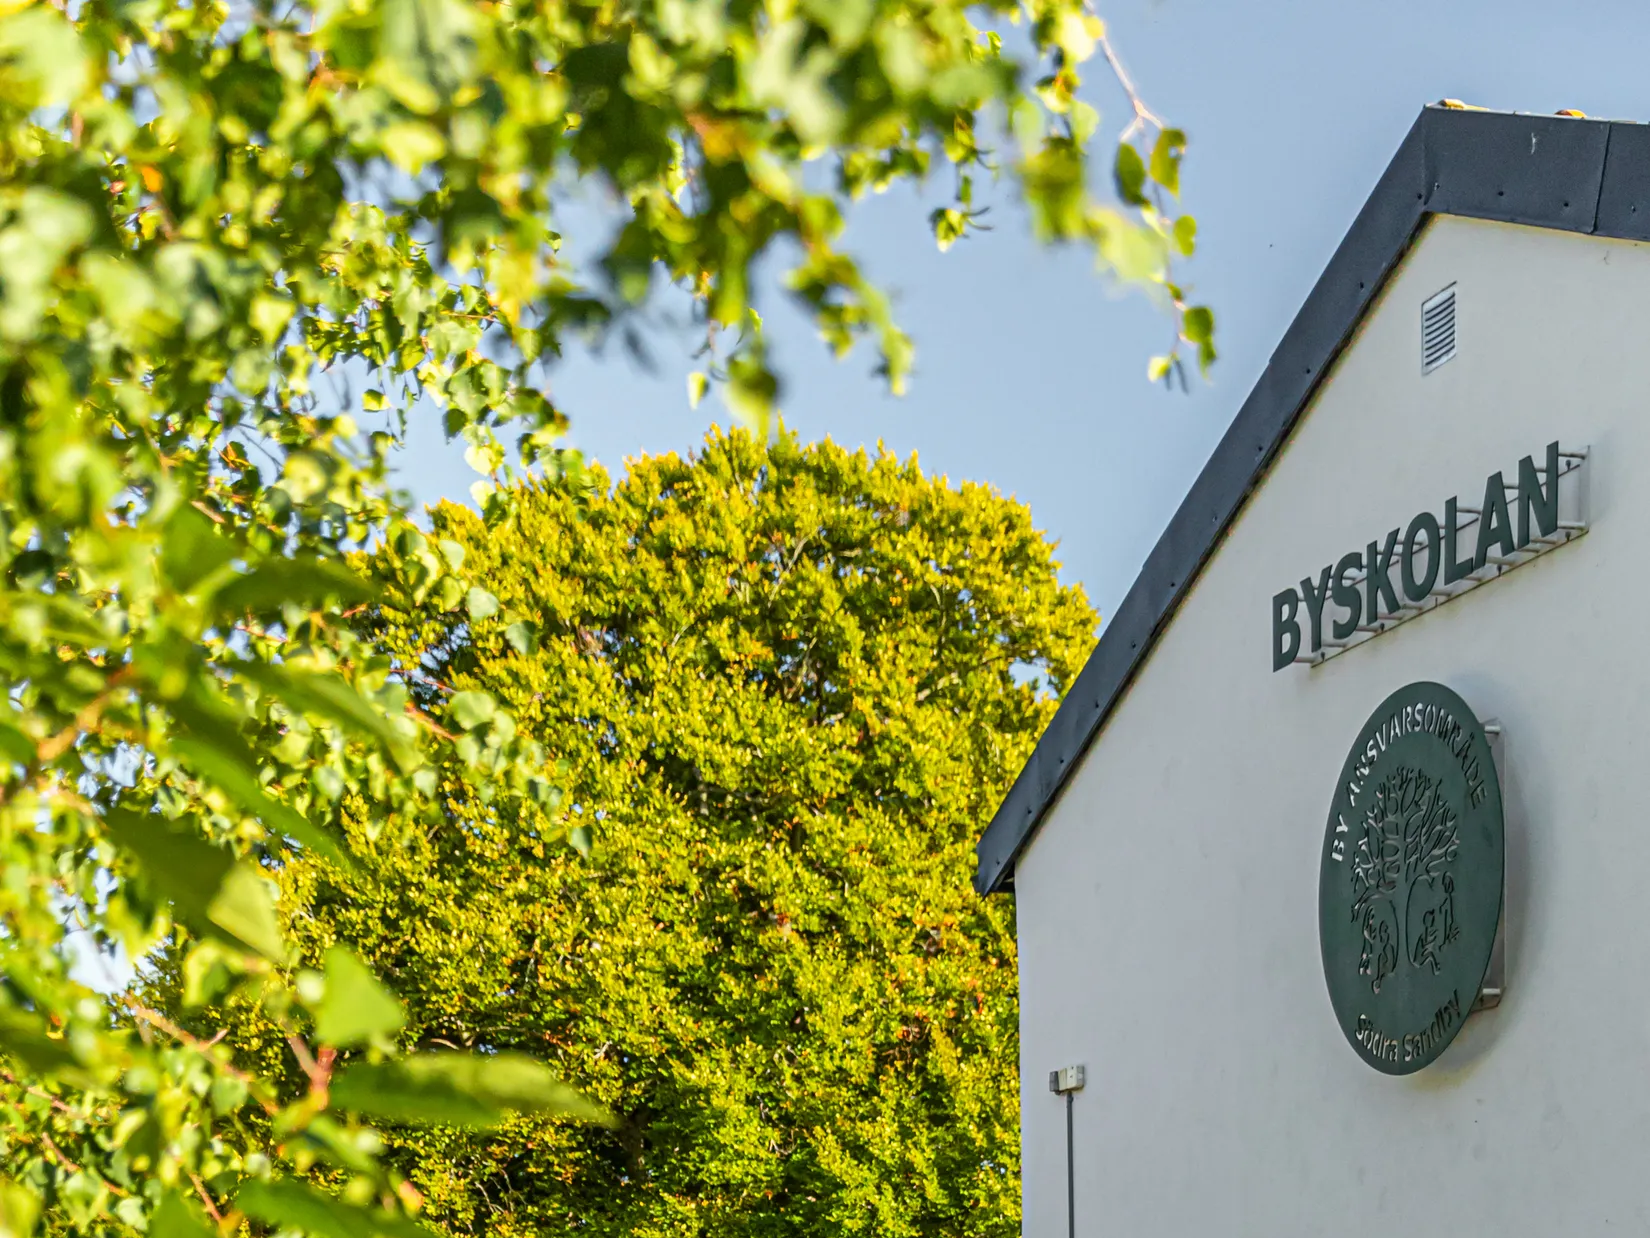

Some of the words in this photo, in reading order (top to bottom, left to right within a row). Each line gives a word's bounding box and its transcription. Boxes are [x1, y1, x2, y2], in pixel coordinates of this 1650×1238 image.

[1272, 440, 1559, 673] BYSKOLAN
[1331, 812, 1349, 862] BY
[1355, 1013, 1398, 1062] Södra
[1402, 988, 1461, 1062] Sandby
